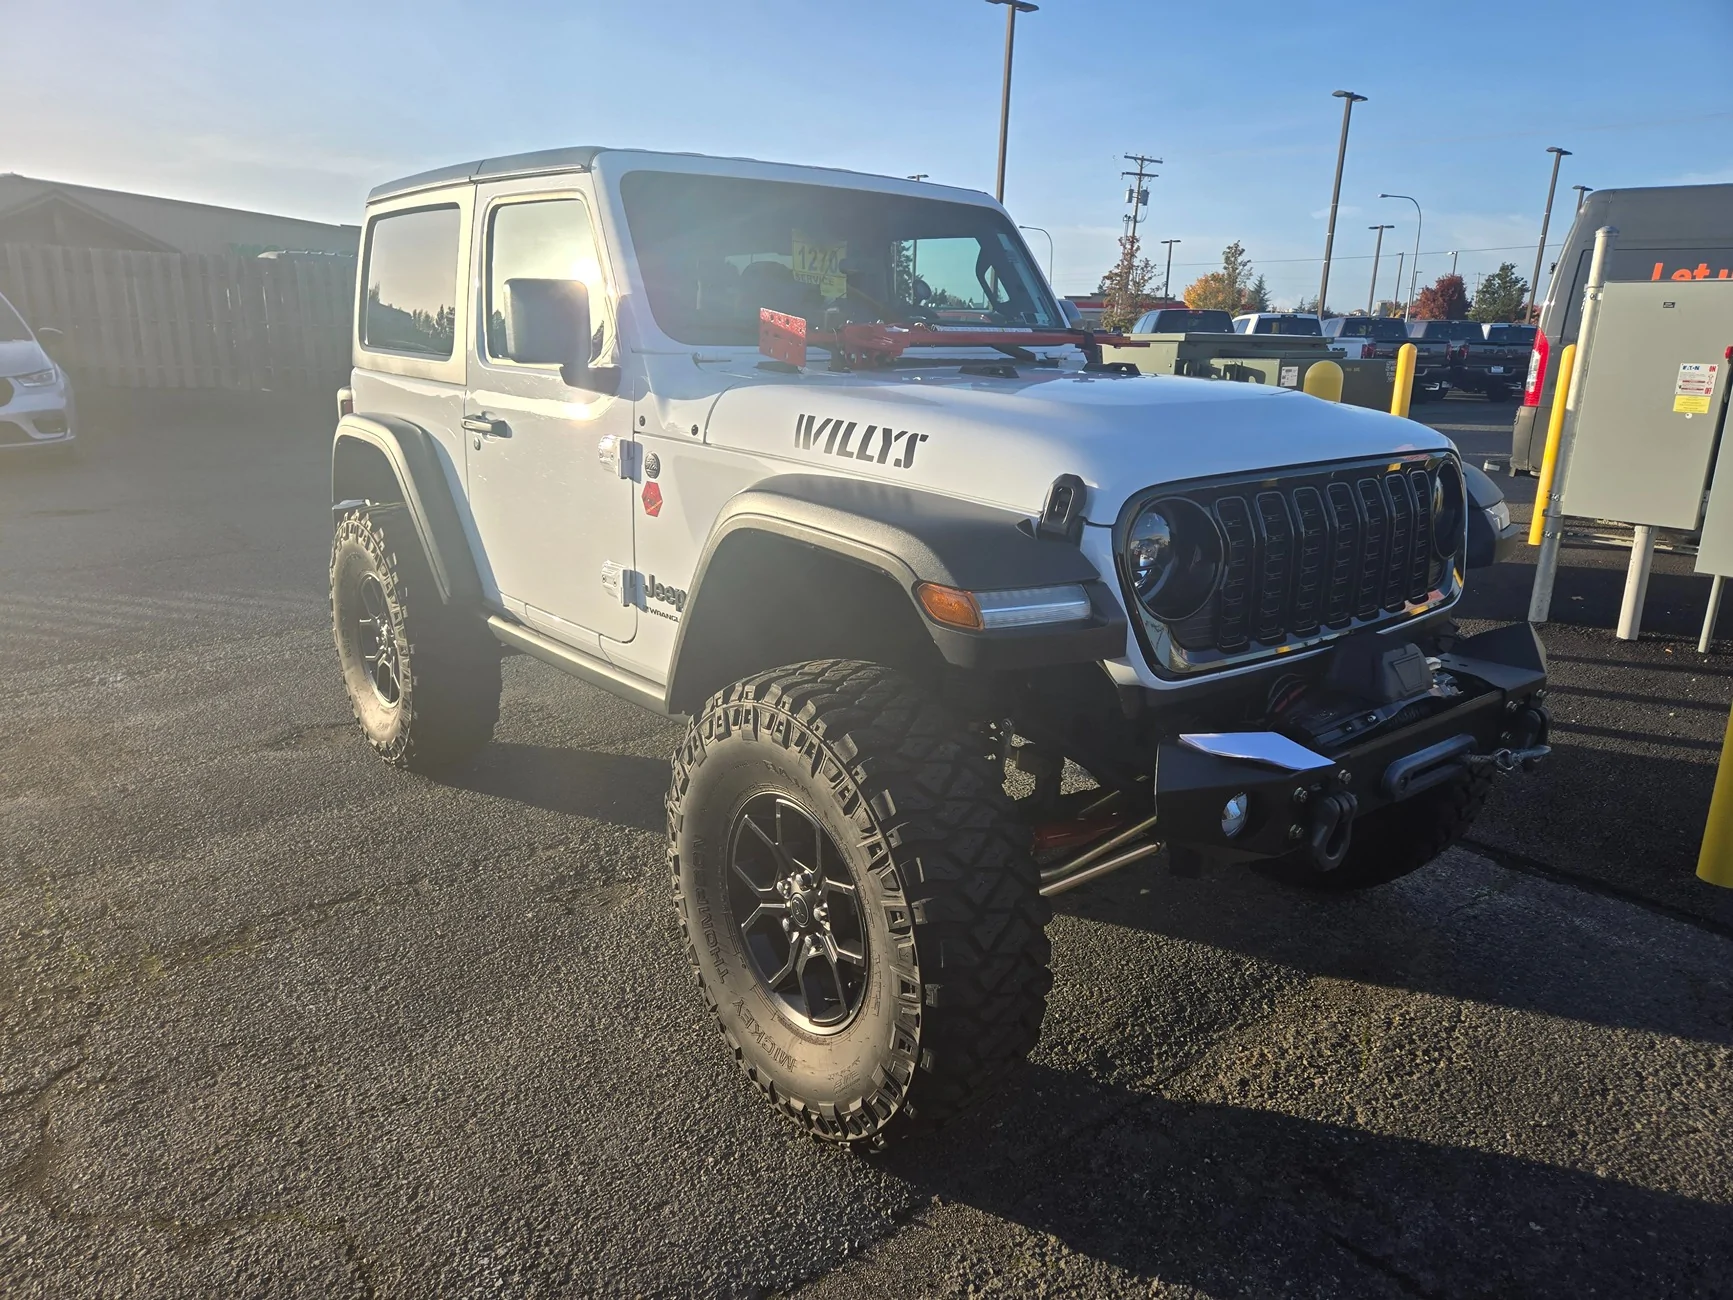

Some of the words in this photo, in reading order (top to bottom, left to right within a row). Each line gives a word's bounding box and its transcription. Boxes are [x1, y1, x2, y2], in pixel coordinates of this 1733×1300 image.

[794, 413, 929, 469] WILLYS
[642, 573, 687, 612] Jeep
[649, 606, 679, 623] WRANGL
[732, 998, 797, 1073] MICKEY
